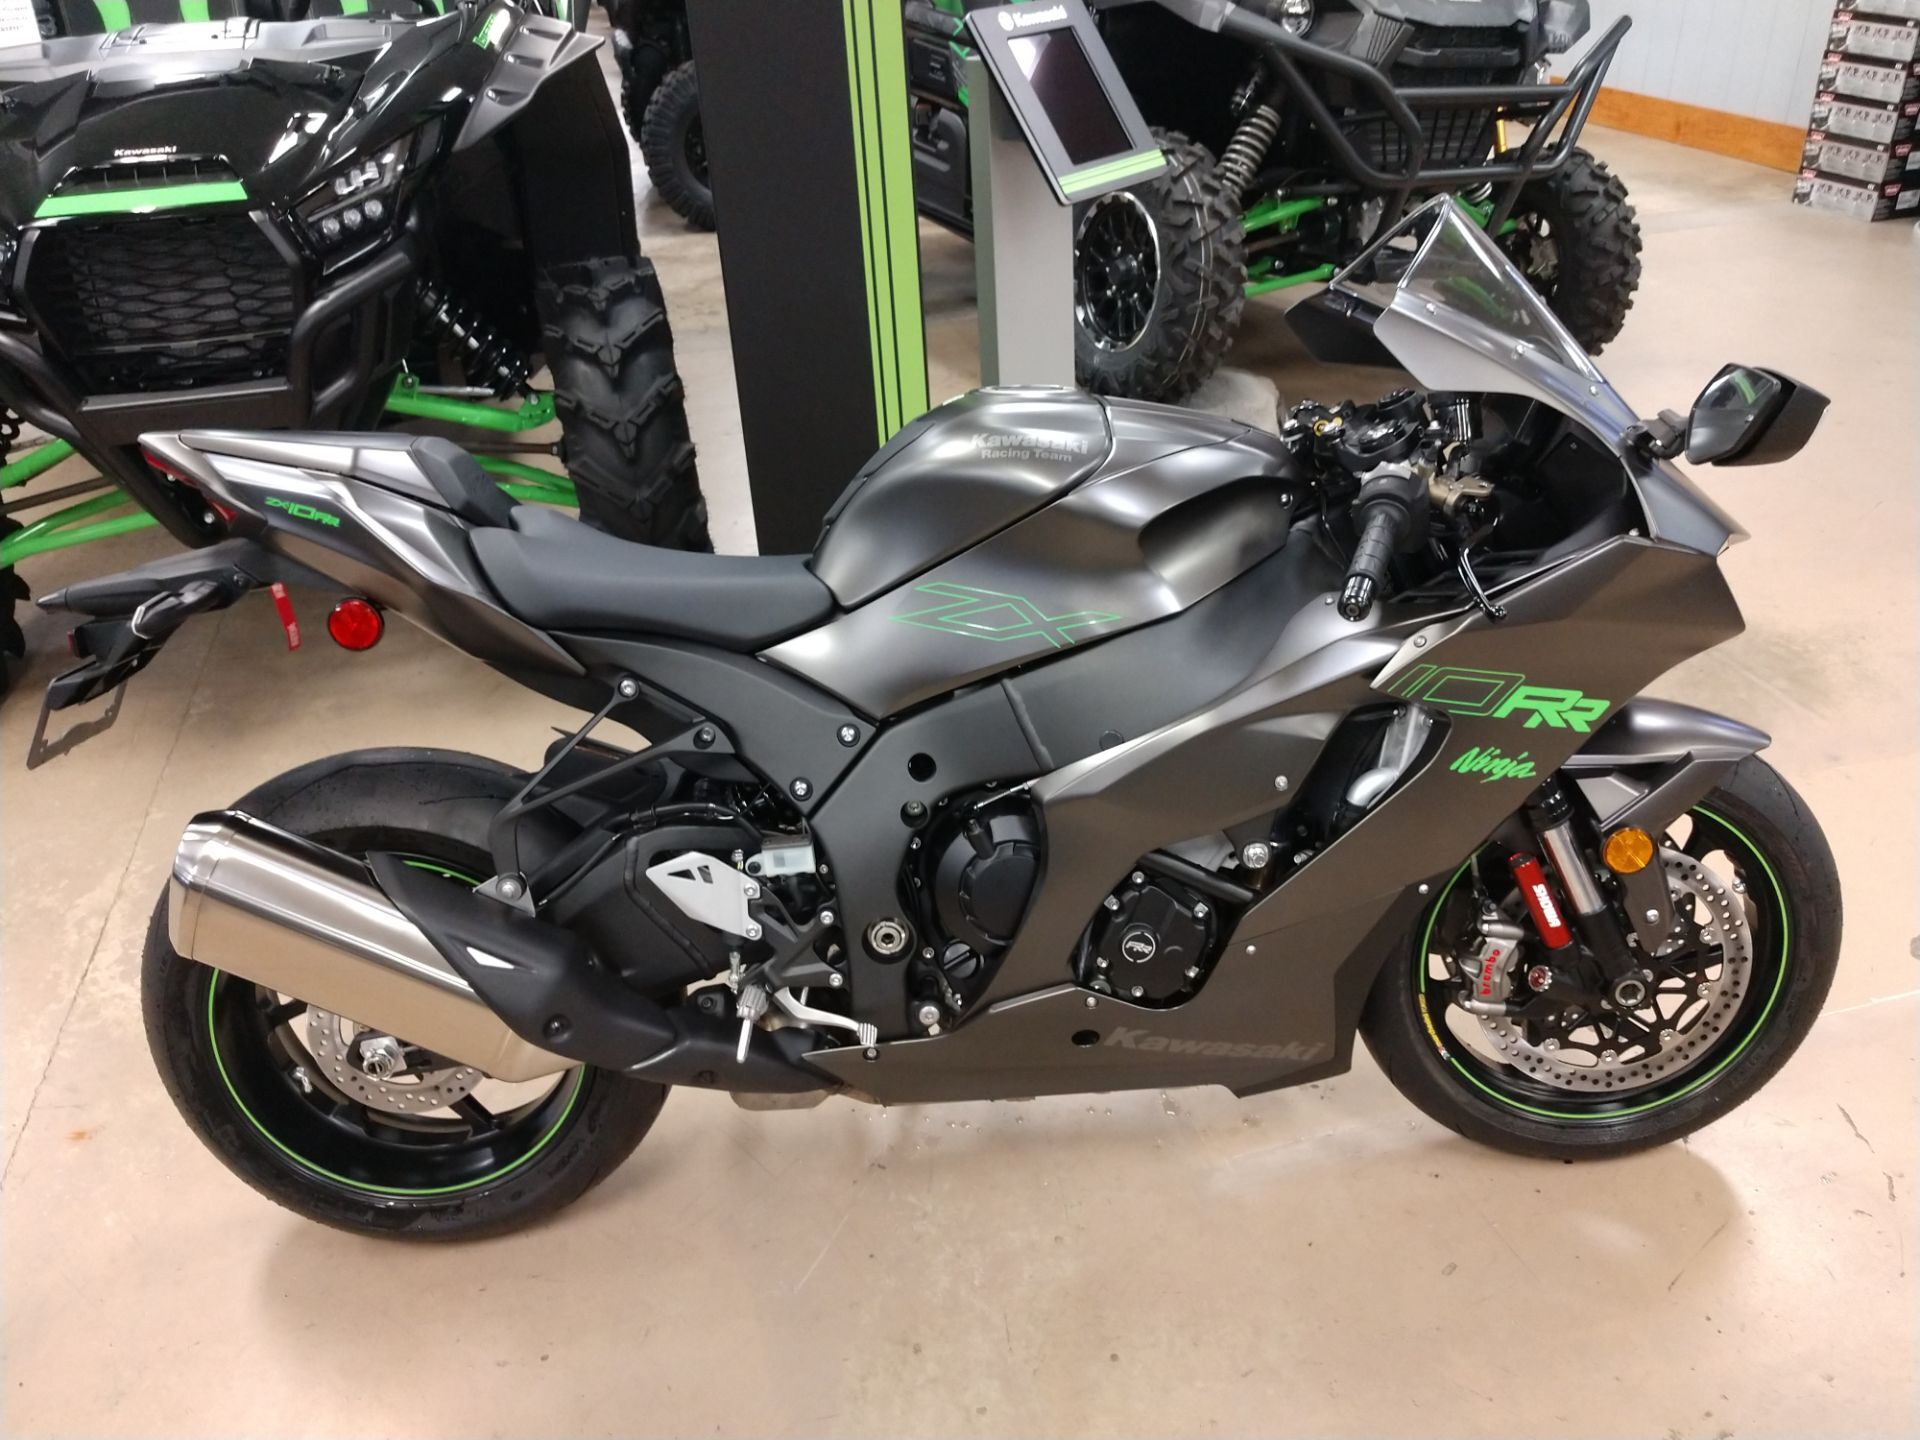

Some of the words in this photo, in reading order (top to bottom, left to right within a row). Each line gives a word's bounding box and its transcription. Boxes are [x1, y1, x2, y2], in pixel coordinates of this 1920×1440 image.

[113, 145, 177, 158] Kawasaki
[971, 432, 1089, 455] Kawasaki
[980, 447, 1031, 460] Racing
[1033, 448, 1073, 462] Team
[1449, 746, 1537, 784] Ninja
[1532, 883, 1562, 928] SHOWA
[1480, 948, 1501, 997] brembo
[1103, 1026, 1326, 1061] Kawasaki
